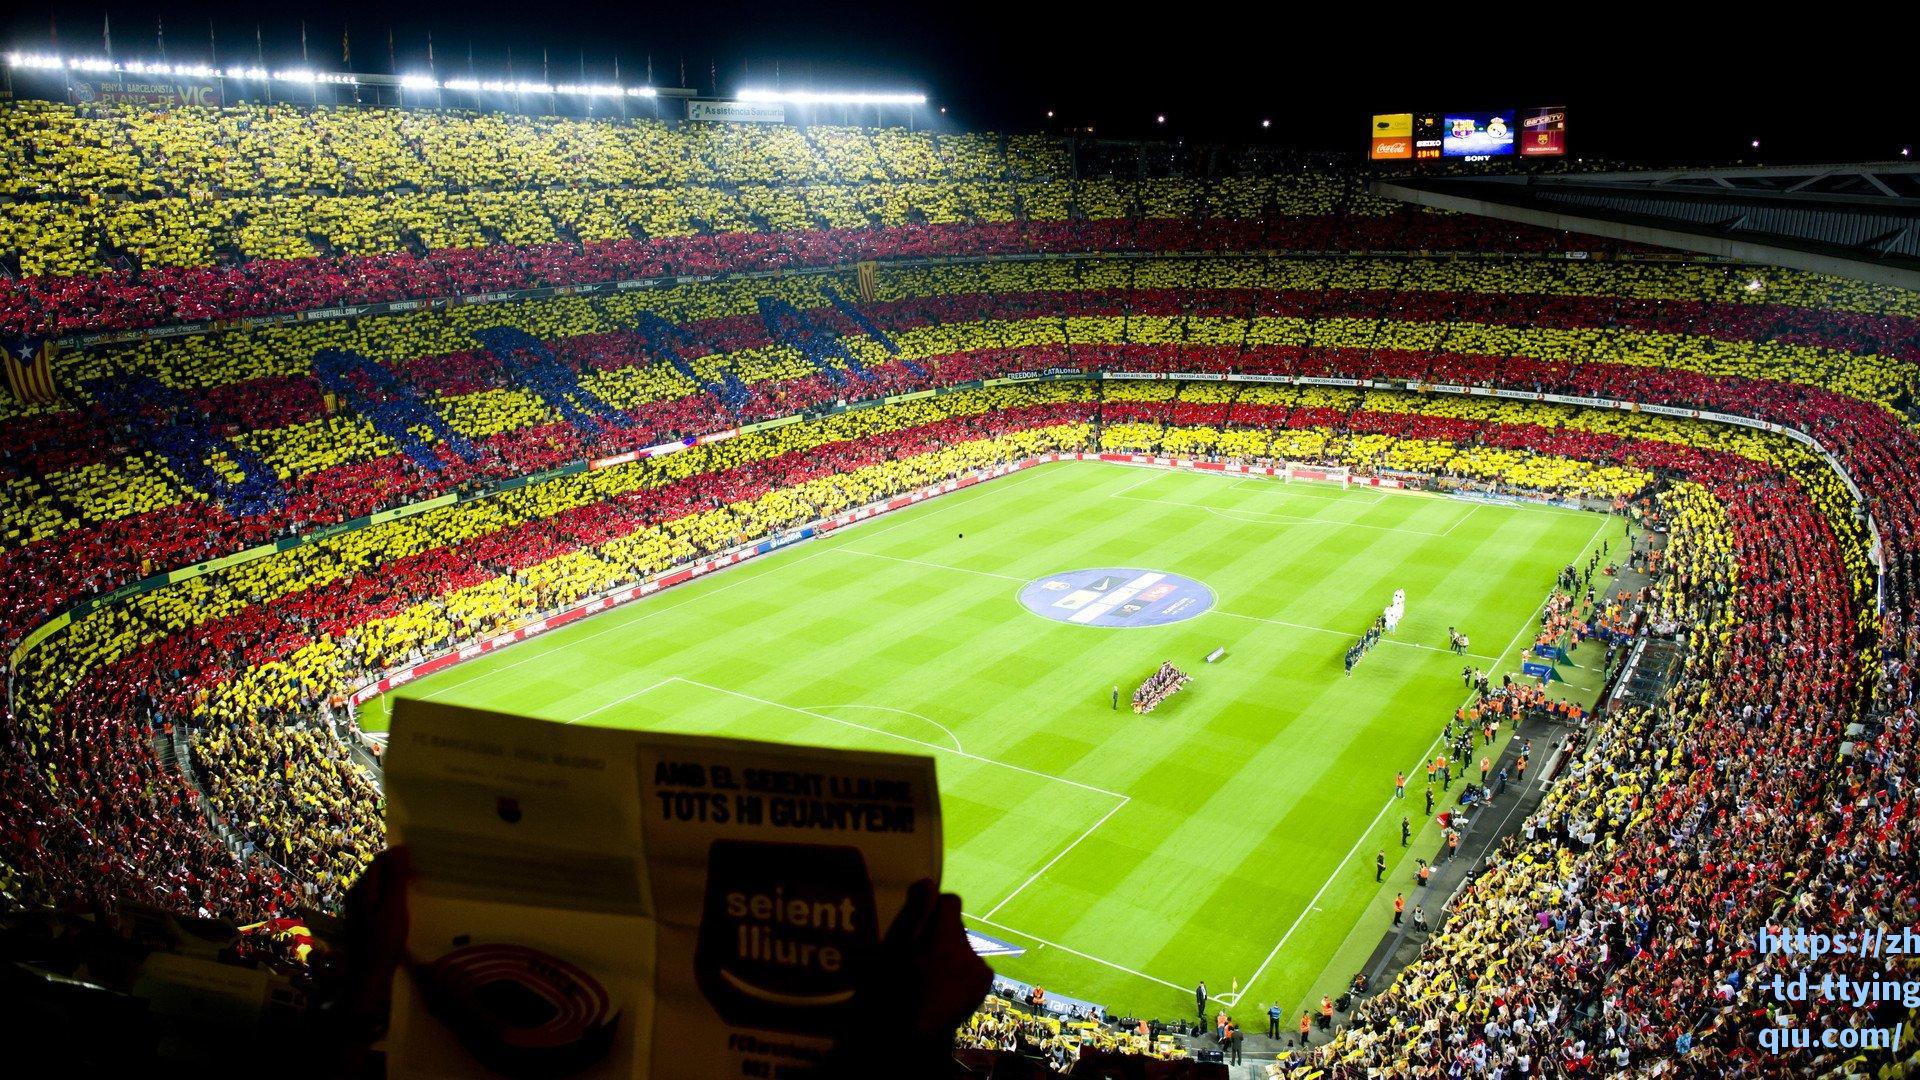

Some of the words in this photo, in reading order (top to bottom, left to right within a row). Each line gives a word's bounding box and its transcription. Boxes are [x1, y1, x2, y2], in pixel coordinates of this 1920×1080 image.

[102, 82, 123, 92] PENYA
[127, 83, 174, 94] BARCELONISTA
[177, 84, 214, 107] VIC
[102, 94, 148, 105] PLANA
[158, 95, 175, 107] DE
[308, 307, 358, 319] NIKEFOOTBALL.COM
[1007, 371, 1038, 380] FREEDOM
[1043, 368, 1081, 376] CATALONIA
[1661, 407, 1689, 416] AIRLINES
[1715, 413, 1739, 422] TURKISH
[1739, 417, 1763, 428] AIRLINES
[655, 761, 706, 788] AMB
[710, 764, 741, 790] EL
[743, 768, 825, 796] SEIENT
[658, 791, 732, 824] TOTS
[735, 795, 765, 826] HI
[726, 884, 856, 932] seient
[738, 924, 844, 972] lliure
